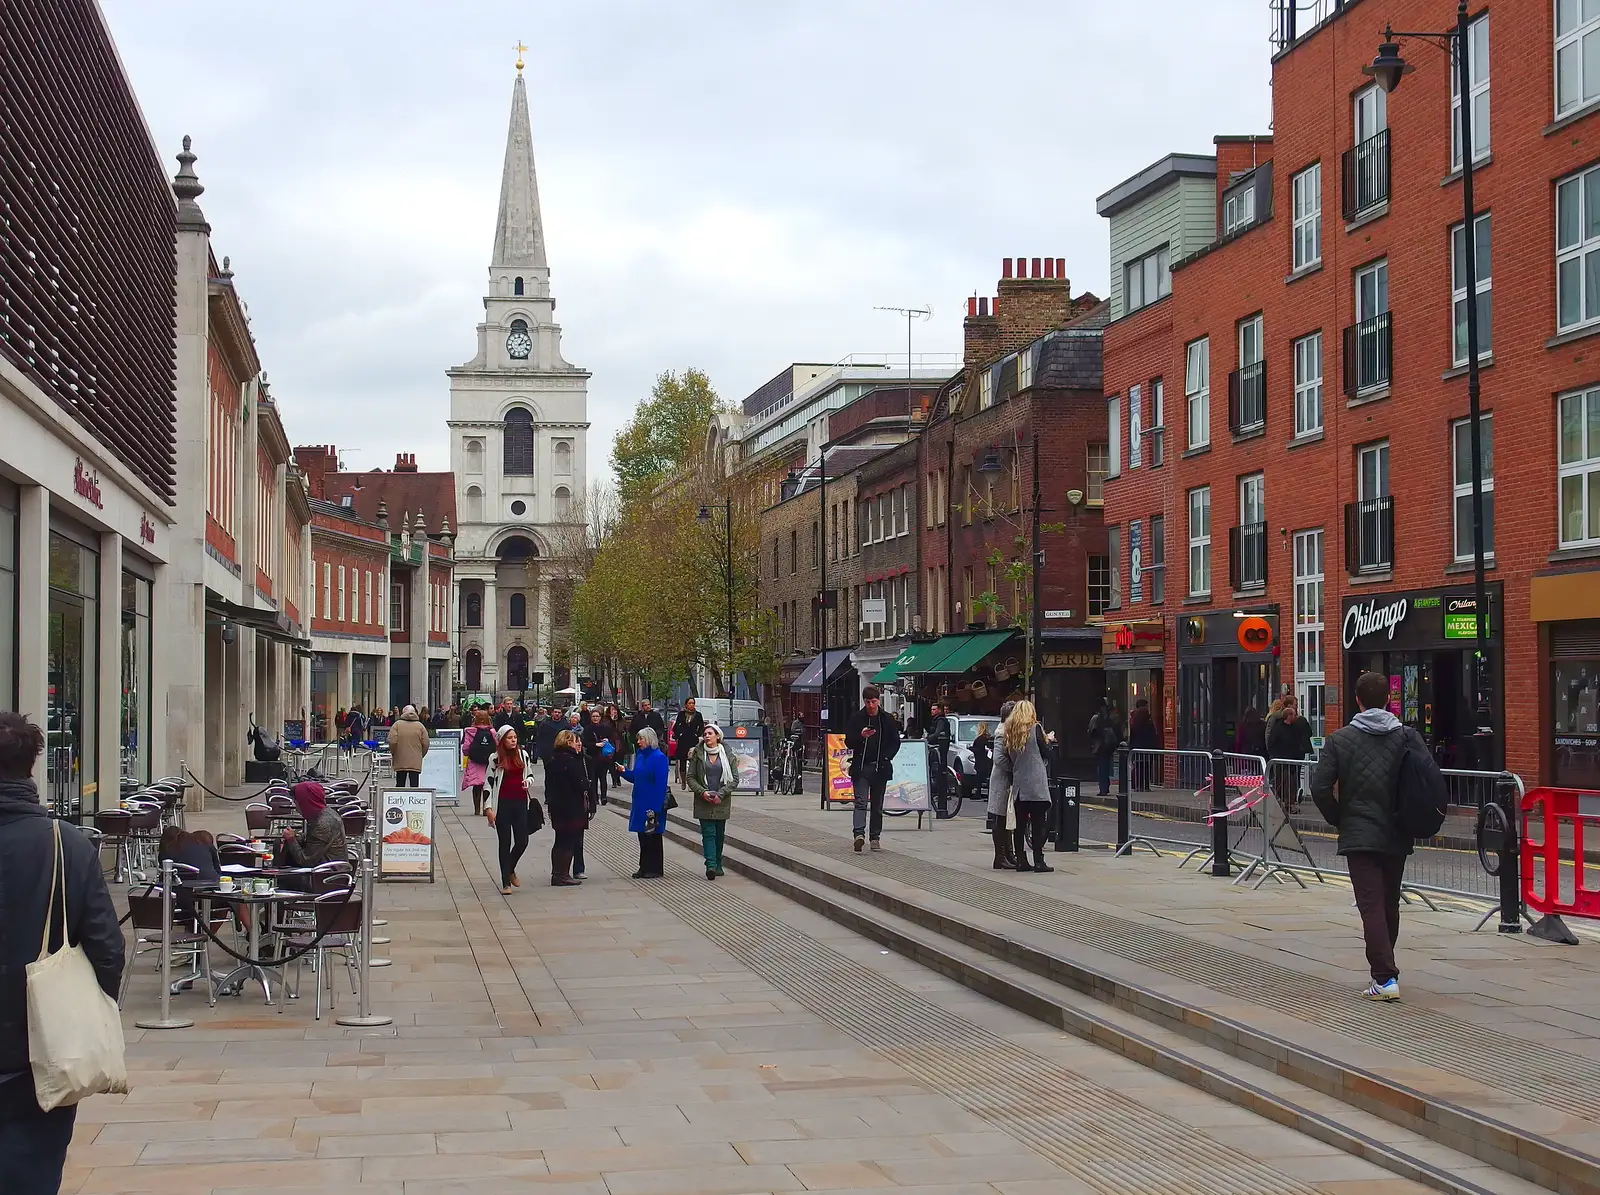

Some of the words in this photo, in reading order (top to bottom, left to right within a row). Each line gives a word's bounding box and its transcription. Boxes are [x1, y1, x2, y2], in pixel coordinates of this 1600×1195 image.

[1449, 599, 1477, 612] Chilan
[1343, 599, 1407, 649] Chilango
[1041, 653, 1103, 666] VERDE
[387, 796, 406, 807] Early
[408, 796, 427, 804] Riser
